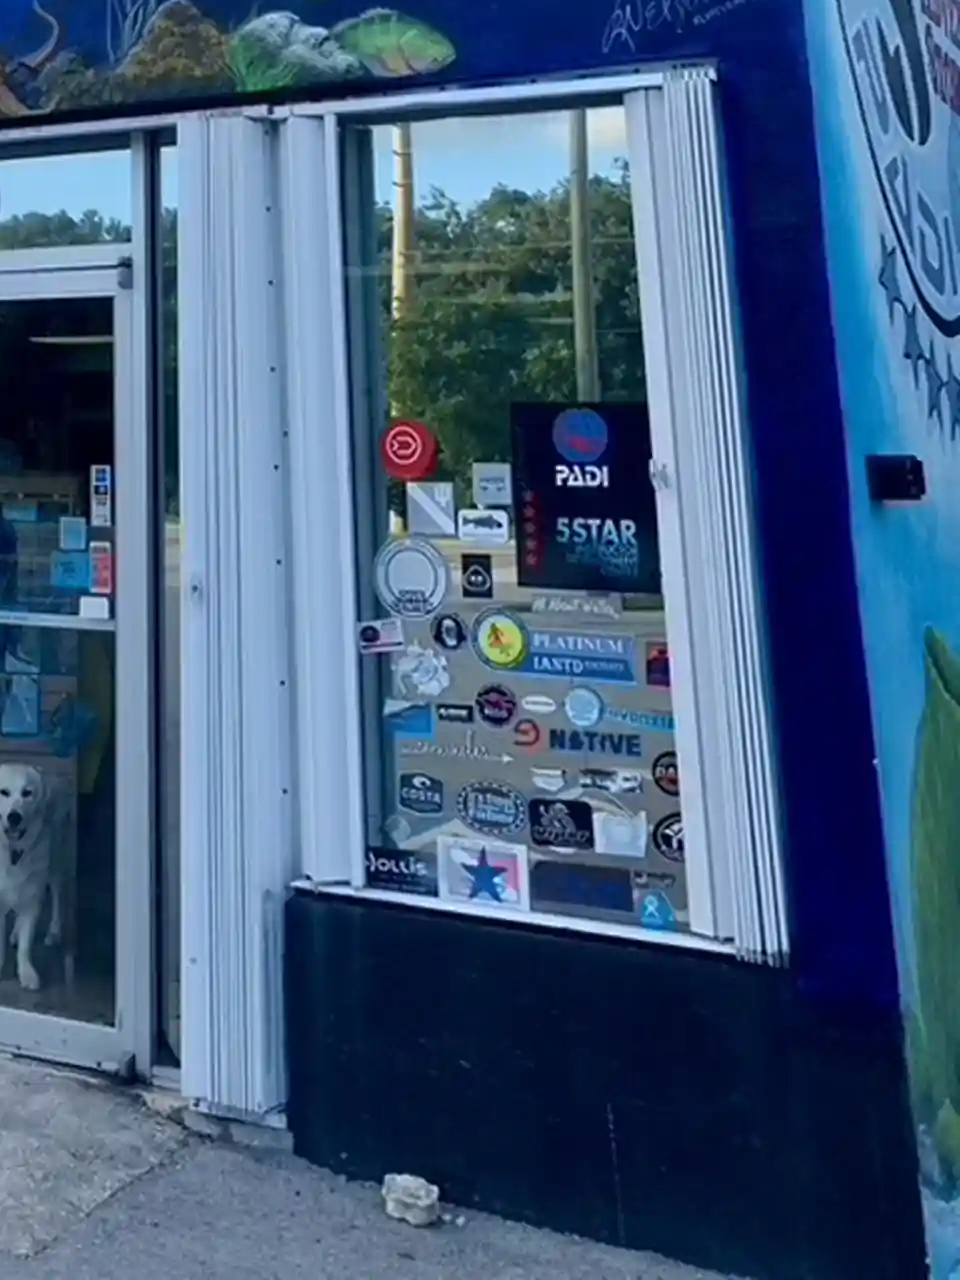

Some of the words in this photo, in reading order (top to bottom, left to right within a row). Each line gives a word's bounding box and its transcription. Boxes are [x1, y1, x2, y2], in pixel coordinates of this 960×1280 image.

[555, 464, 609, 488] PADI
[533, 631, 625, 654] PLATINUM
[549, 729, 642, 757] NATIVE
[401, 785, 440, 804] COSTA
